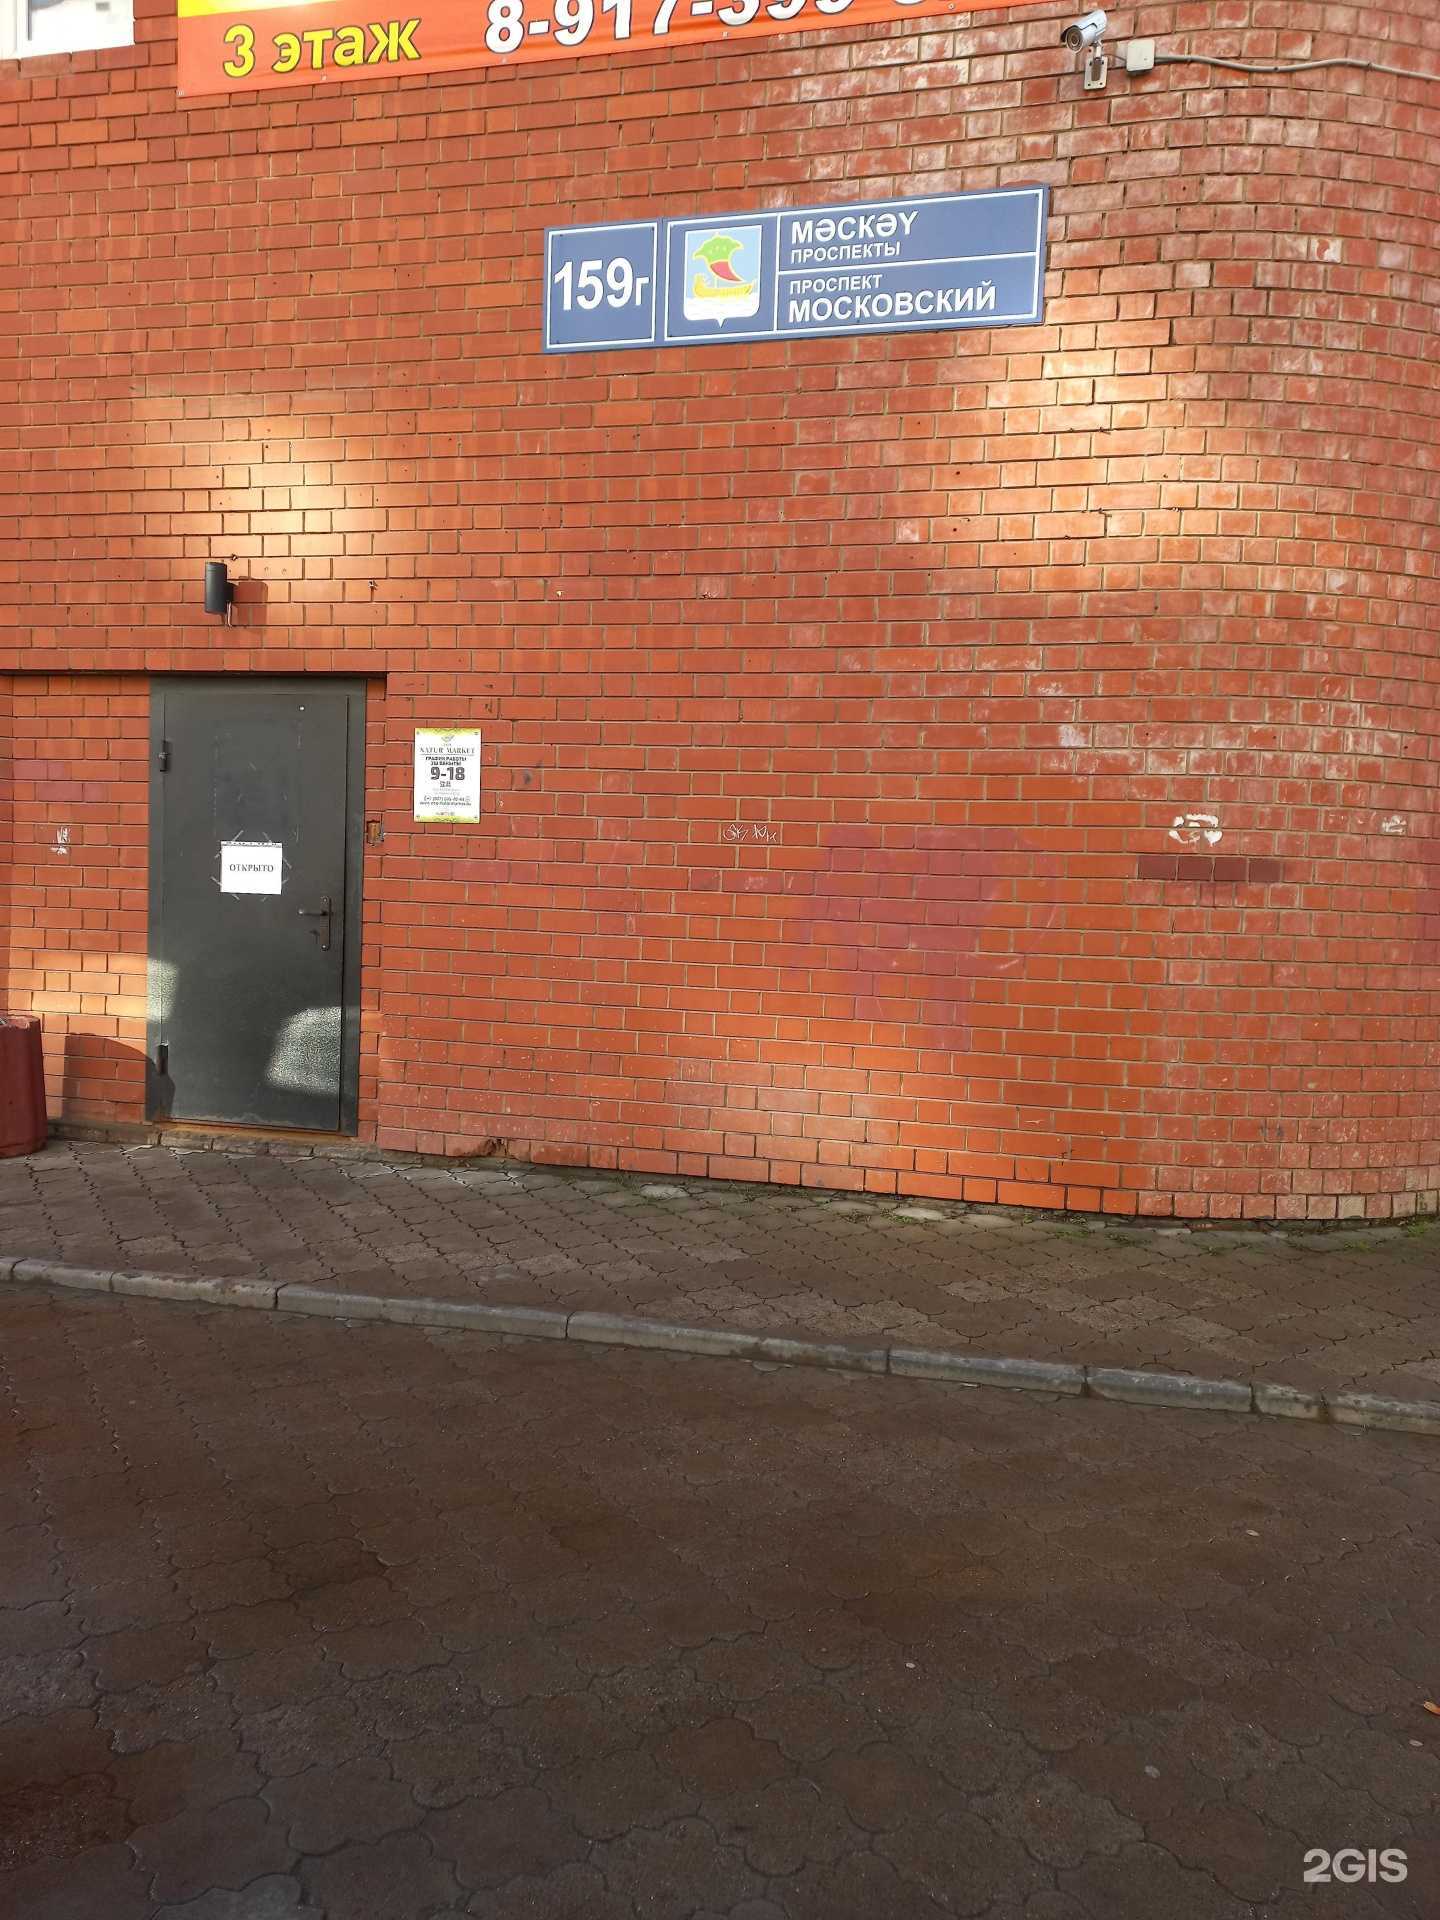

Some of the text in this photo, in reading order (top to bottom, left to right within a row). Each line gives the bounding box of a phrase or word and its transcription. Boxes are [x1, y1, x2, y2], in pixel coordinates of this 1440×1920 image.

[223, 18, 421, 77] 3 этаж
[791, 241, 901, 264] ПРОСПЕКТЫ
[554, 257, 650, 311] 159г
[789, 274, 883, 295] ПРОСПЕКТ
[788, 279, 997, 323] МОСКОВСКИЙ
[430, 766, 465, 781] 9-18
[229, 863, 274, 873] ОТКРЫТО
